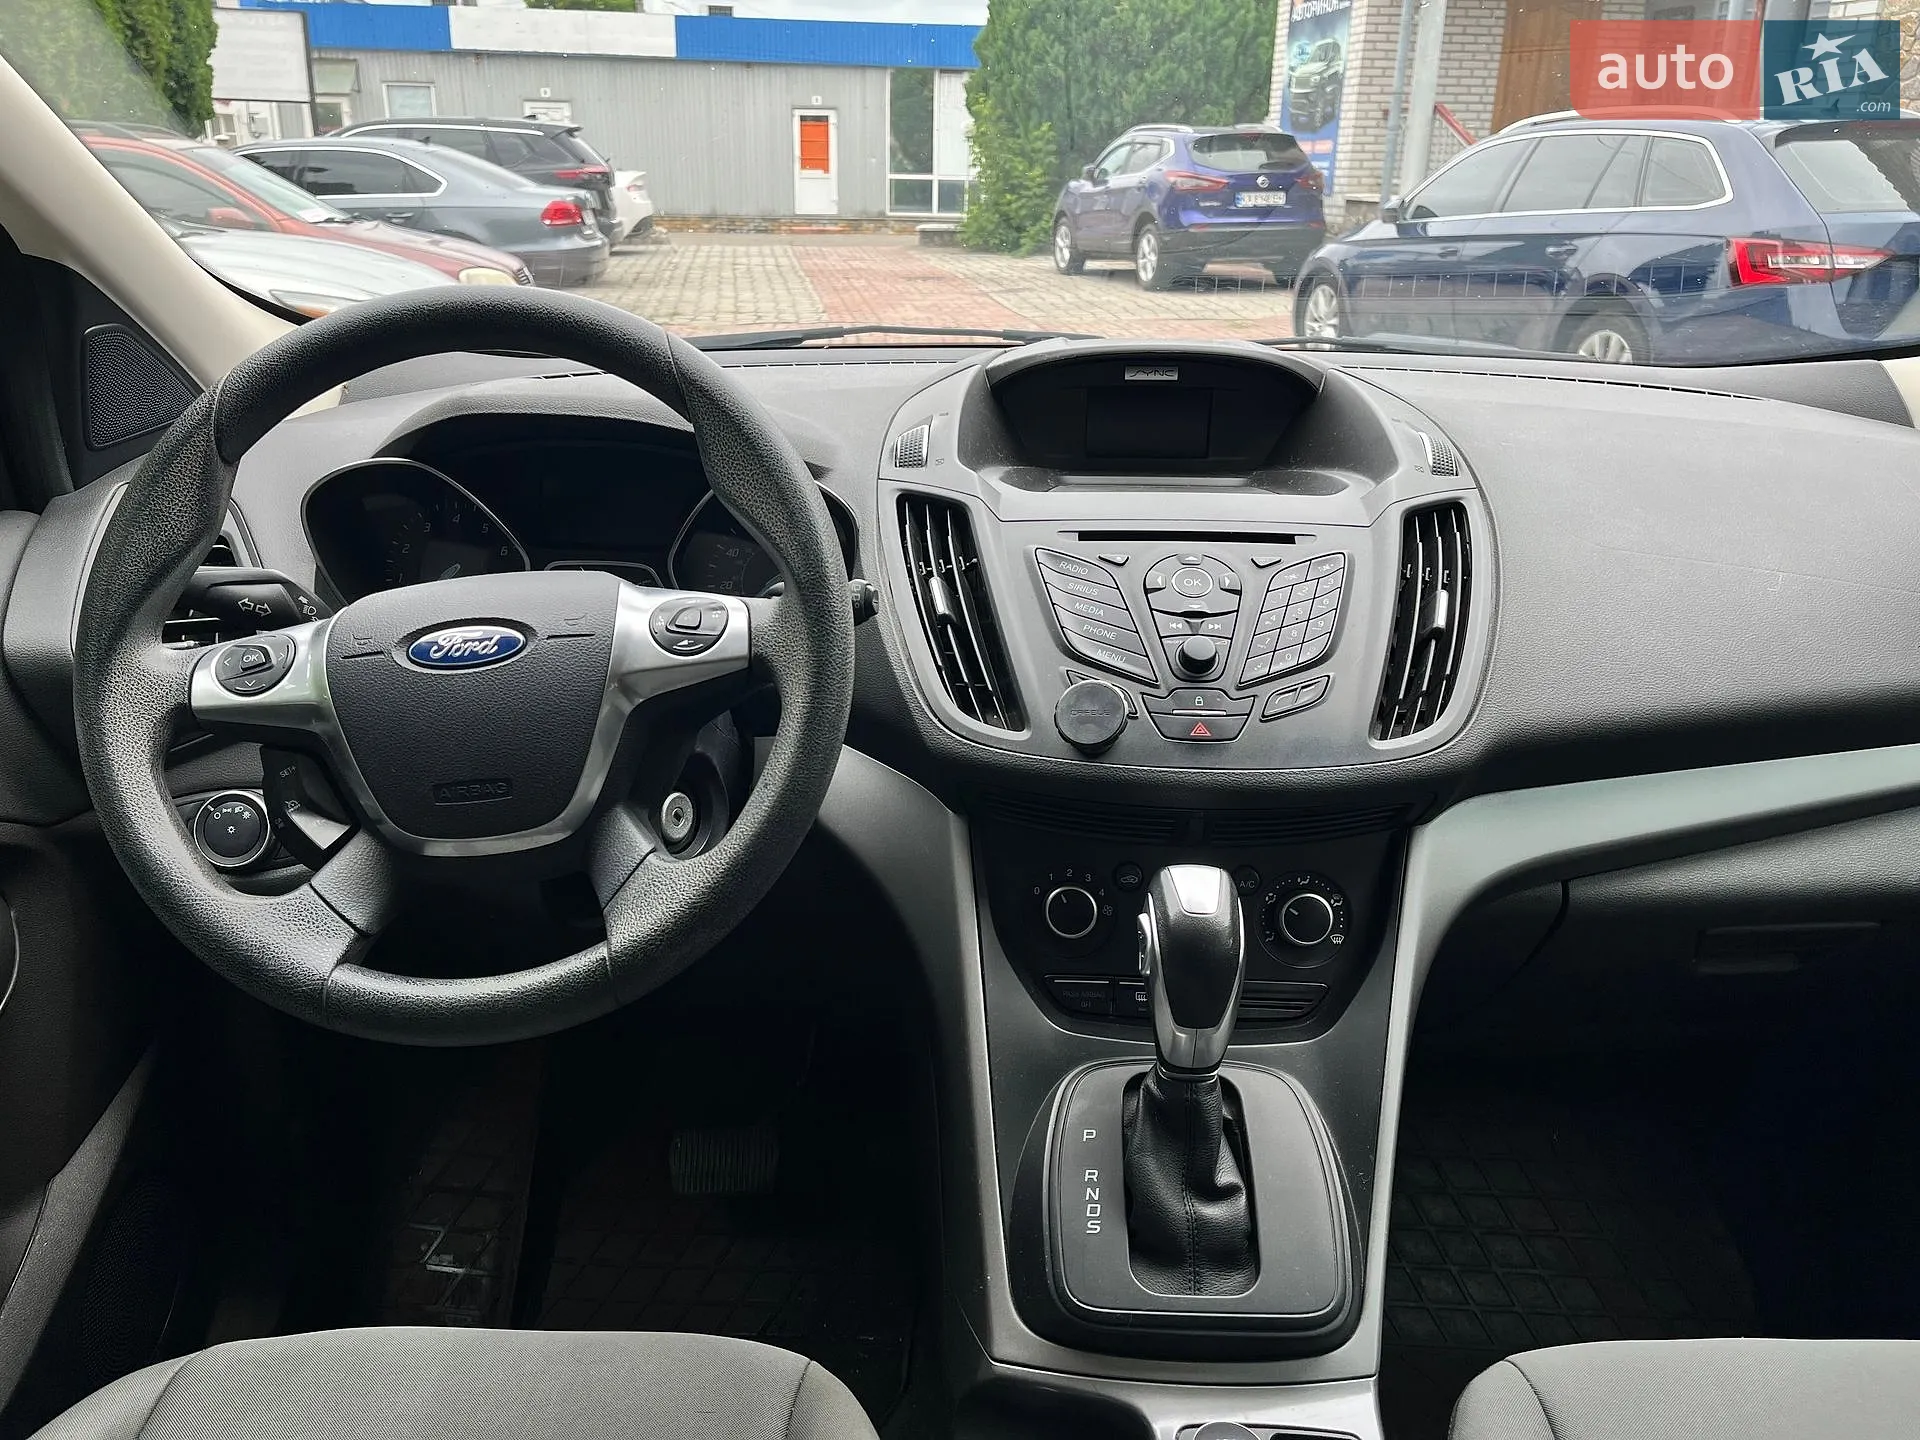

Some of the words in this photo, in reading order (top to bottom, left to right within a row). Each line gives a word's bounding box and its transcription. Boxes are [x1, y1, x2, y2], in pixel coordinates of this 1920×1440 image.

[1129, 368, 1175, 378] SYNC
[423, 522, 431, 533] 3
[481, 523, 489, 534] 5
[402, 543, 410, 554] 2
[500, 545, 508, 556] 6
[725, 548, 739, 558] 40
[1060, 560, 1088, 576] RADIO
[719, 580, 733, 590] 20
[1183, 577, 1202, 587] OK
[1067, 582, 1099, 597] SIRIUS
[1074, 601, 1104, 618] MEDIA
[1083, 623, 1117, 641] PHONE
[430, 630, 500, 659] Ford
[242, 653, 259, 662] OK
[1096, 648, 1126, 663] MENU
[1066, 868, 1073, 877] 2
[1085, 873, 1092, 882] 3
[1239, 880, 1255, 889] A/C
[1034, 886, 1040, 895] 0
[1099, 888, 1105, 896] 4
[1083, 1129, 1097, 1141] P
[1084, 1169, 1099, 1182] R
[1085, 1187, 1100, 1200] N
[1086, 1203, 1101, 1217] D
[1086, 1220, 1102, 1234] S
